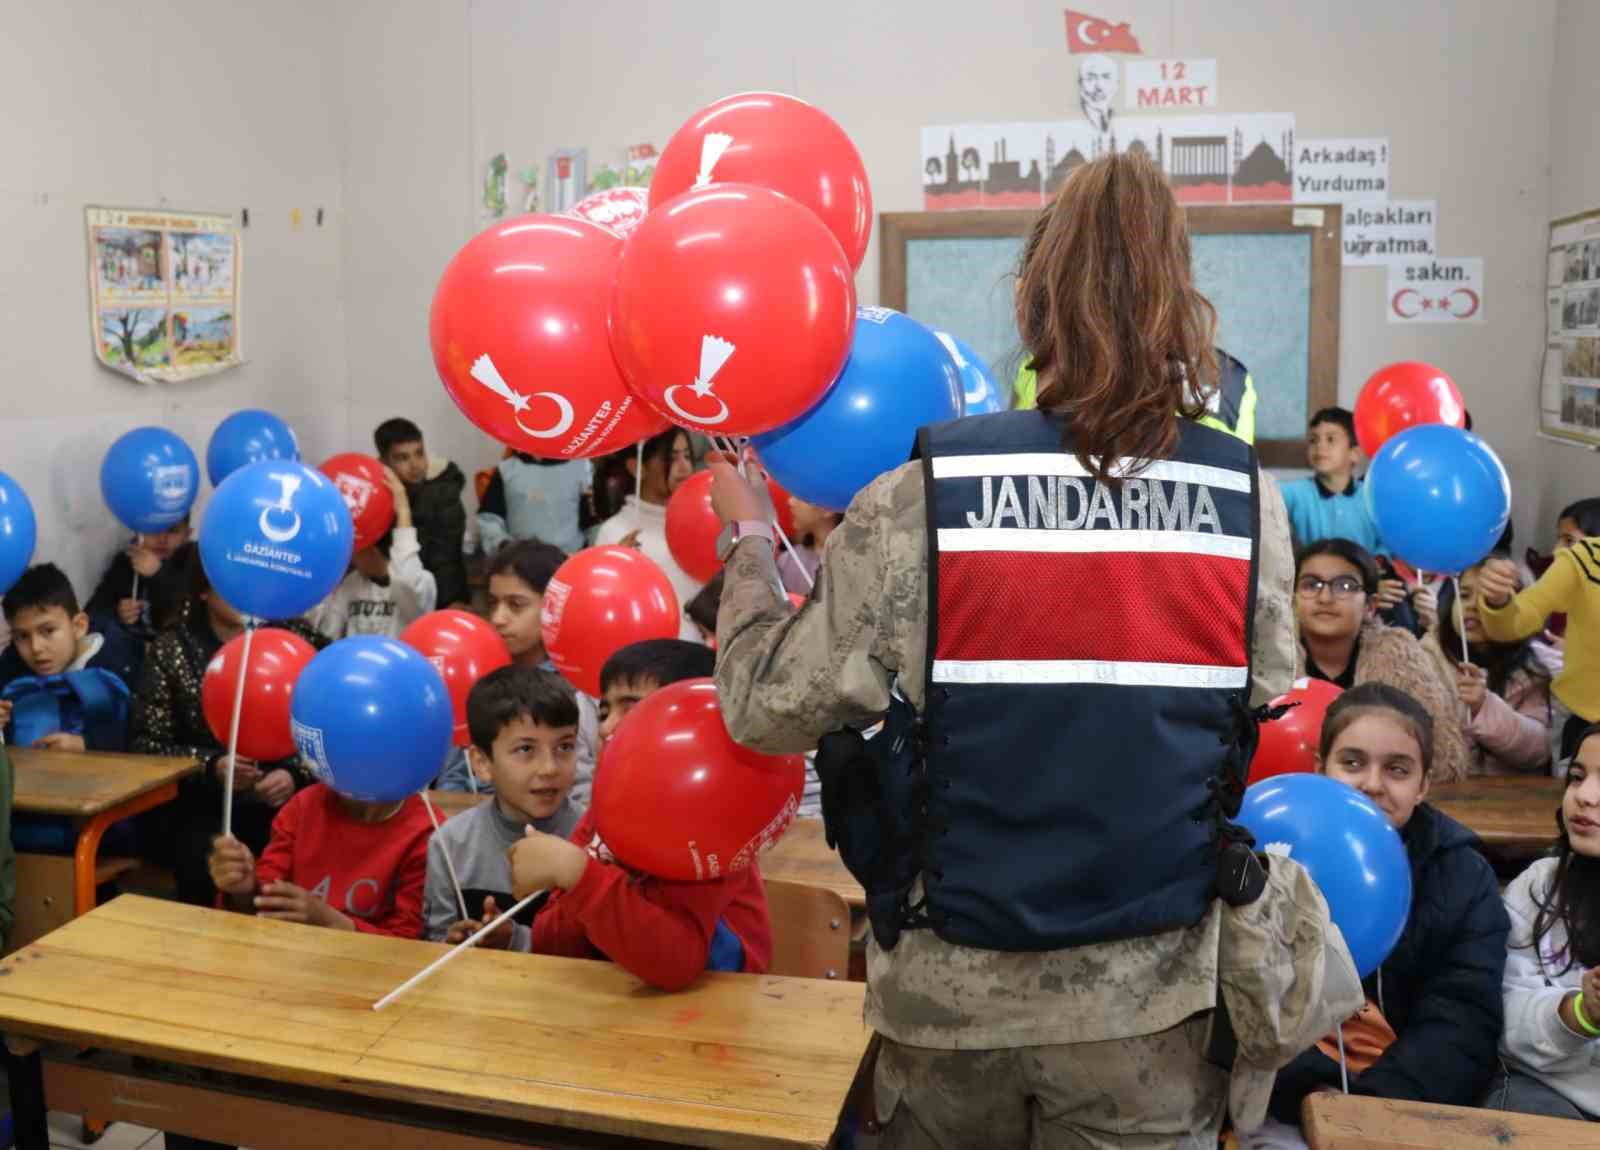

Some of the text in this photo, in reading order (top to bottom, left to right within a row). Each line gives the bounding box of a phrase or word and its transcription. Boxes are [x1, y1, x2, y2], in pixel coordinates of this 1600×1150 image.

[1137, 86, 1208, 107] MART
[1298, 175, 1386, 192] Yurduma
[1344, 207, 1432, 228] alçakları
[966, 474, 1223, 535] JANDARMA
